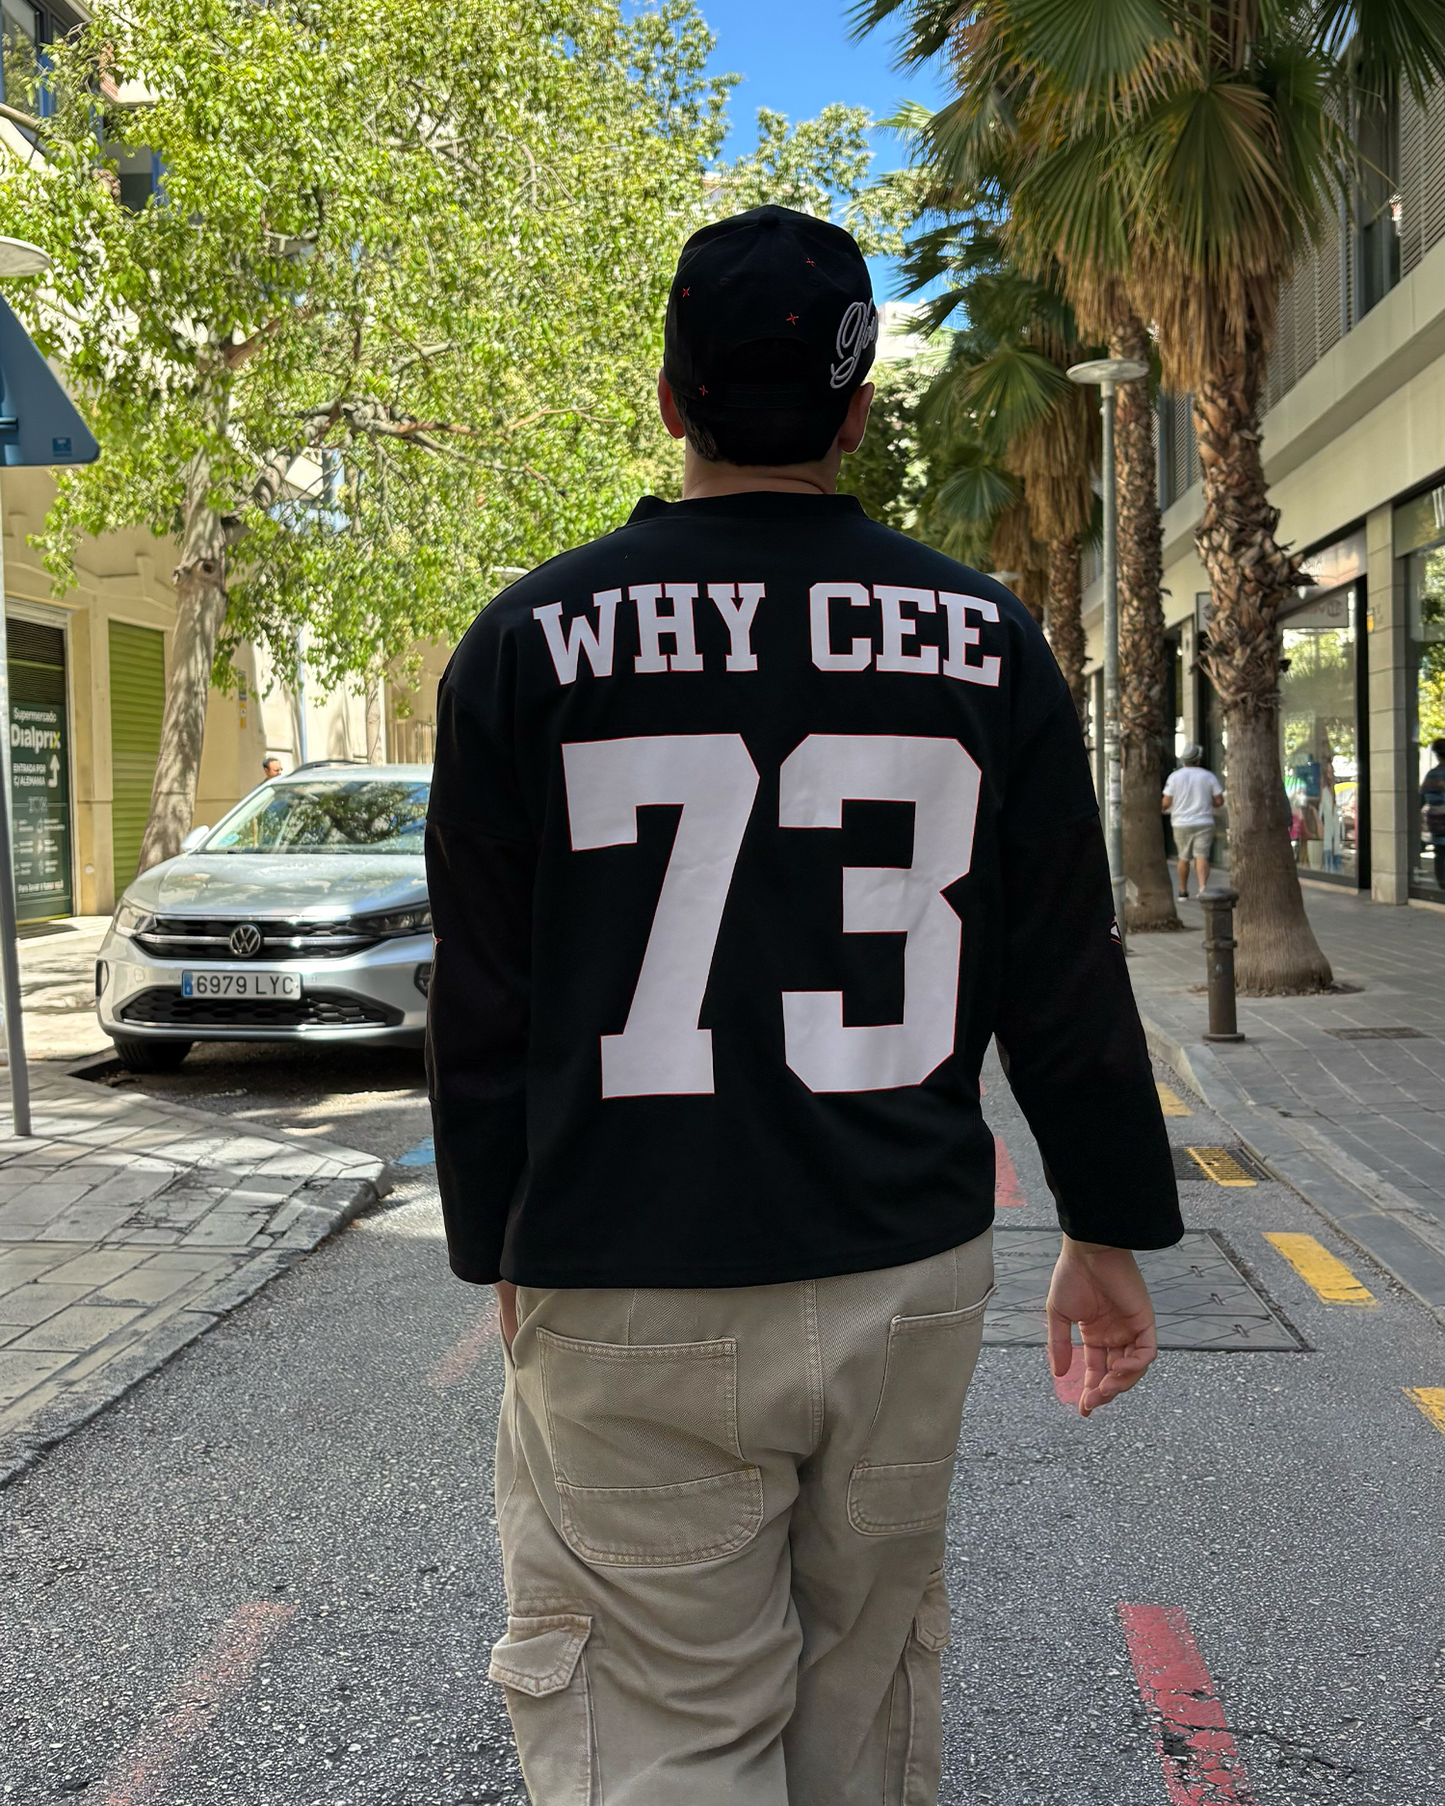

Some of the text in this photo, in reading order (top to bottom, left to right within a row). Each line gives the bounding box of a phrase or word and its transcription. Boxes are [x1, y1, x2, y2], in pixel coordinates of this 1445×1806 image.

[532, 582, 1001, 688] WHY CEE
[11, 723, 61, 755] Dialprix
[561, 732, 982, 1100] 73
[196, 975, 294, 995] 6979 LYC
